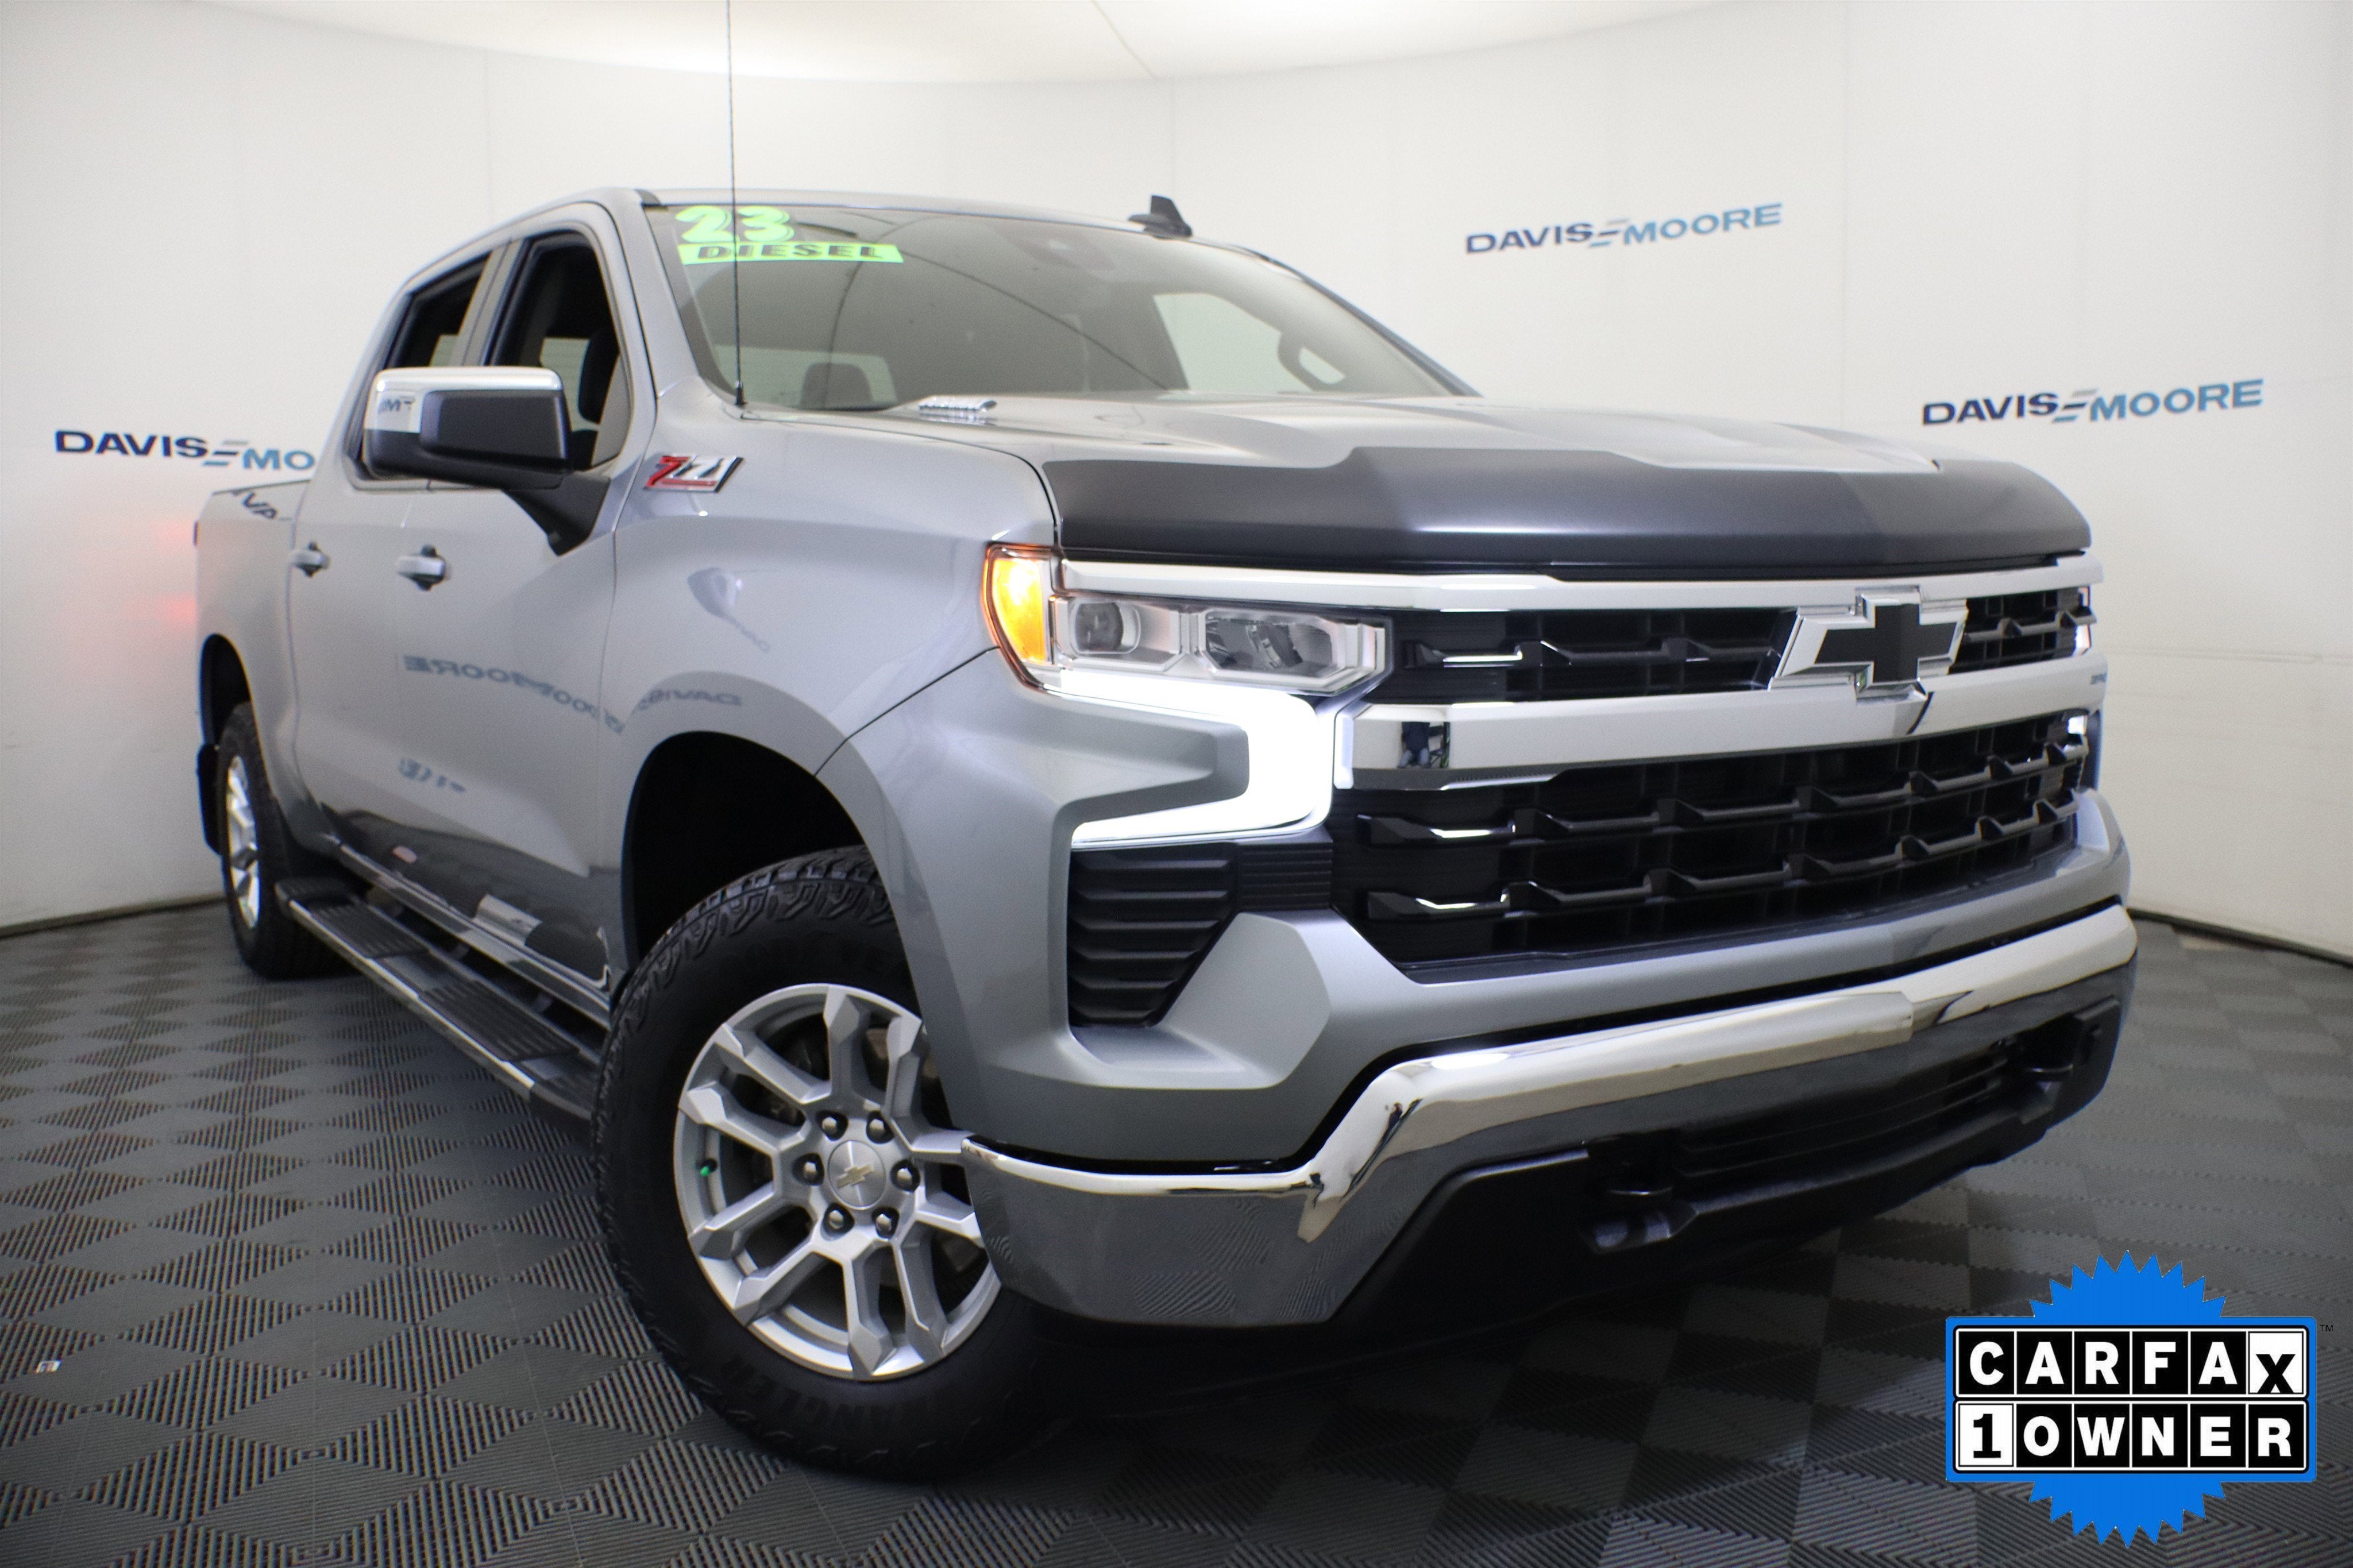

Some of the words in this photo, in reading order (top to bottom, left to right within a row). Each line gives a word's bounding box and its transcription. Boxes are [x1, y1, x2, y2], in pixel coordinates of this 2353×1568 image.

[675, 205, 795, 243] 23
[1465, 222, 1594, 254] DAVIS
[1622, 203, 1783, 245] MOORE
[697, 244, 885, 260] DIESEL
[1922, 392, 2058, 425] DAVIS
[2090, 379, 2264, 422] MOORE
[55, 430, 208, 458] DAVIS
[242, 448, 315, 470] MO
